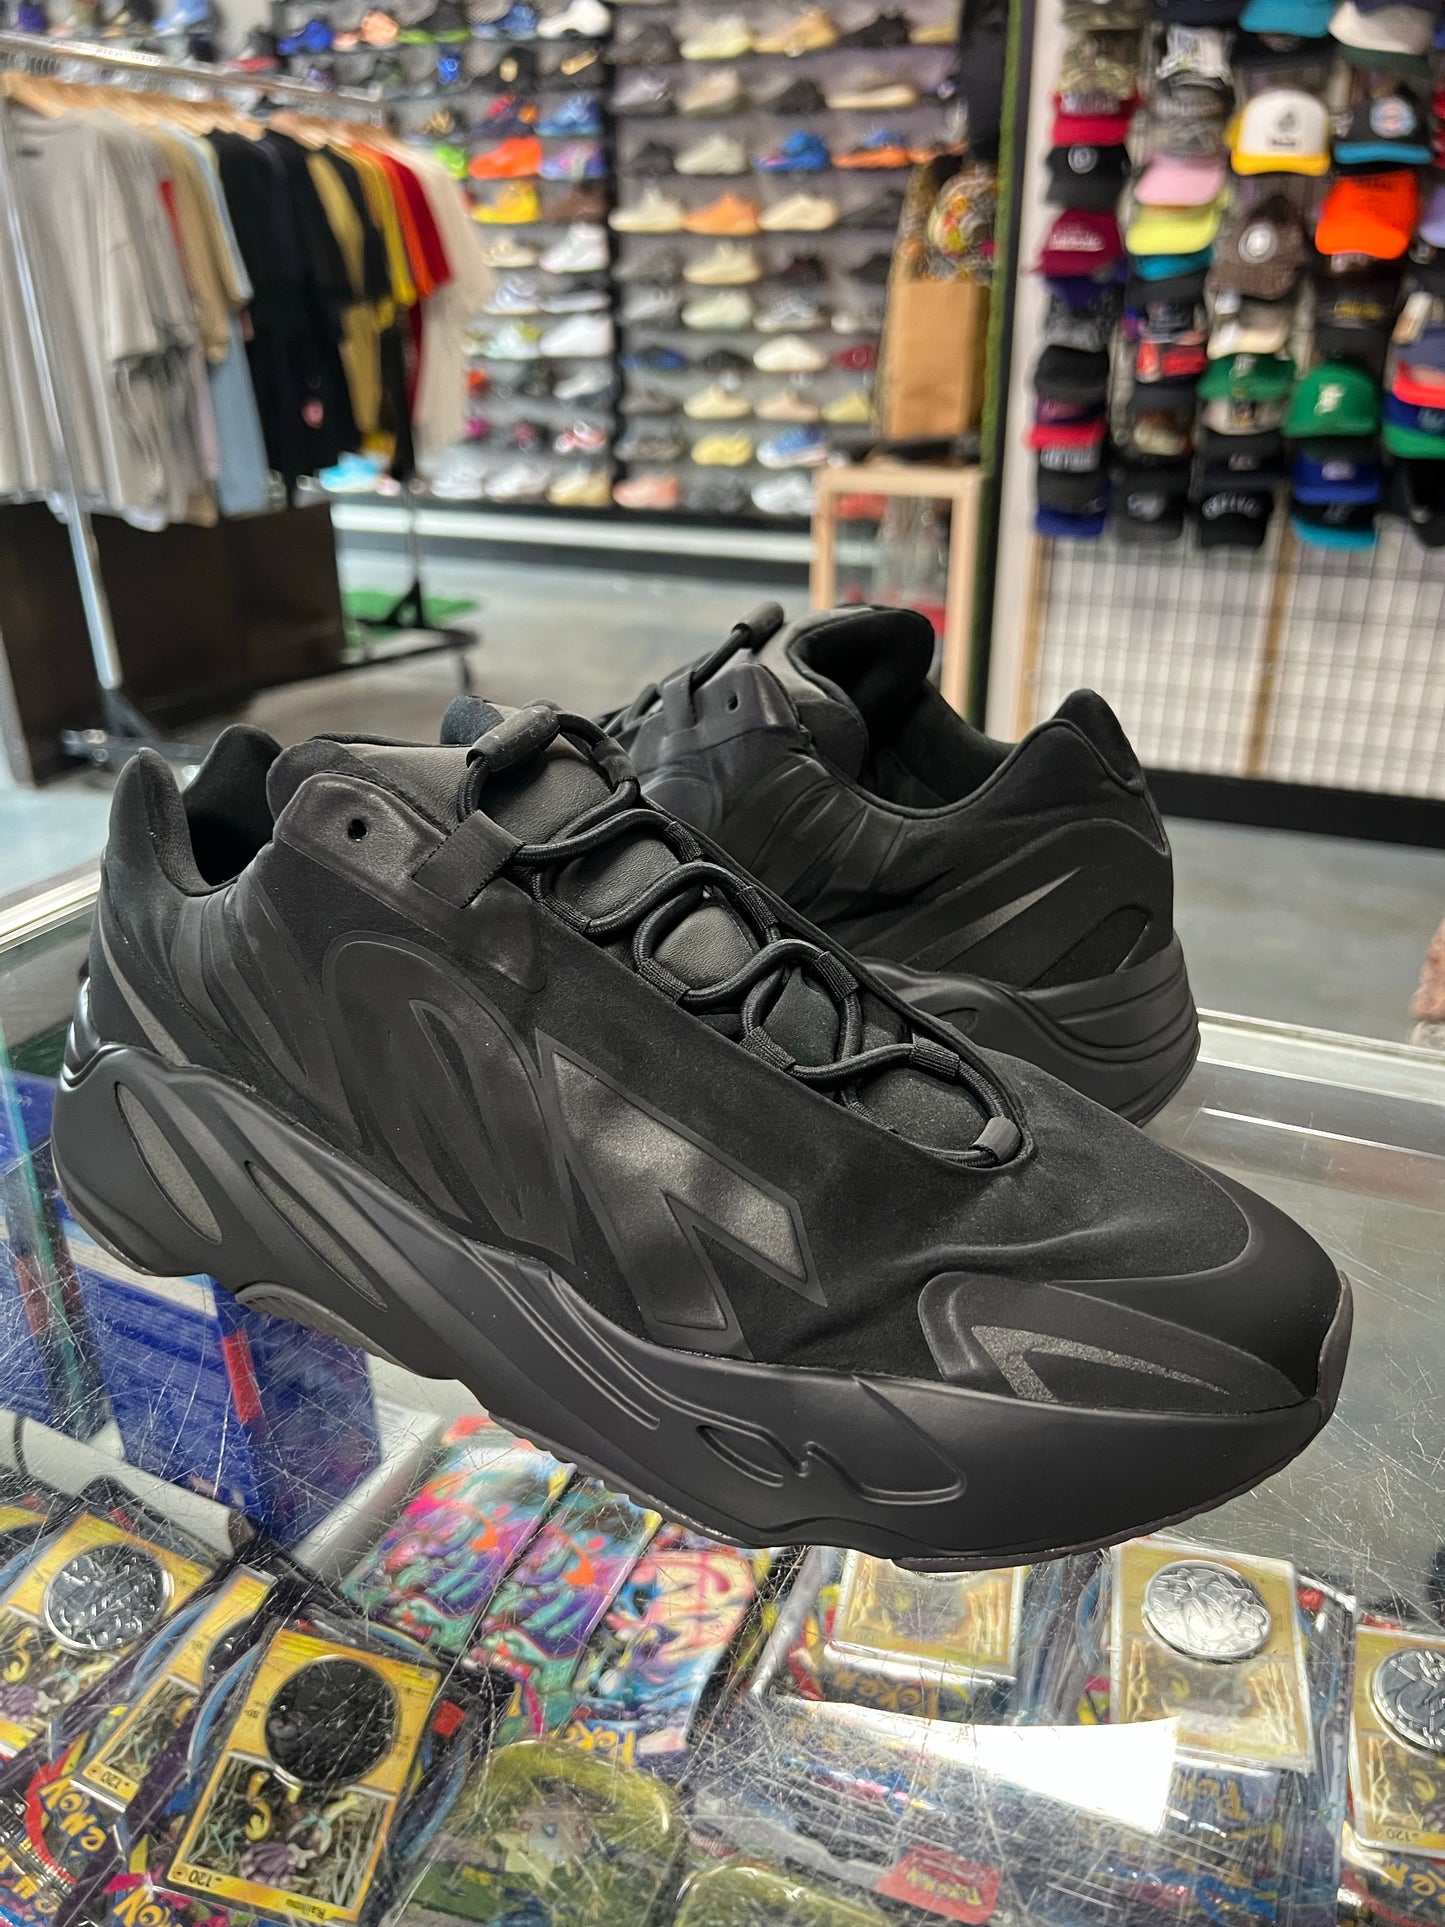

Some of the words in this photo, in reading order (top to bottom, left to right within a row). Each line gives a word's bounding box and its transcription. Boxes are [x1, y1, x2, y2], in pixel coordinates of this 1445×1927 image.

[100, 1770, 121, 1789] 120
[1386, 1828, 1411, 1842] 120
[188, 1869, 213, 1888] 120
